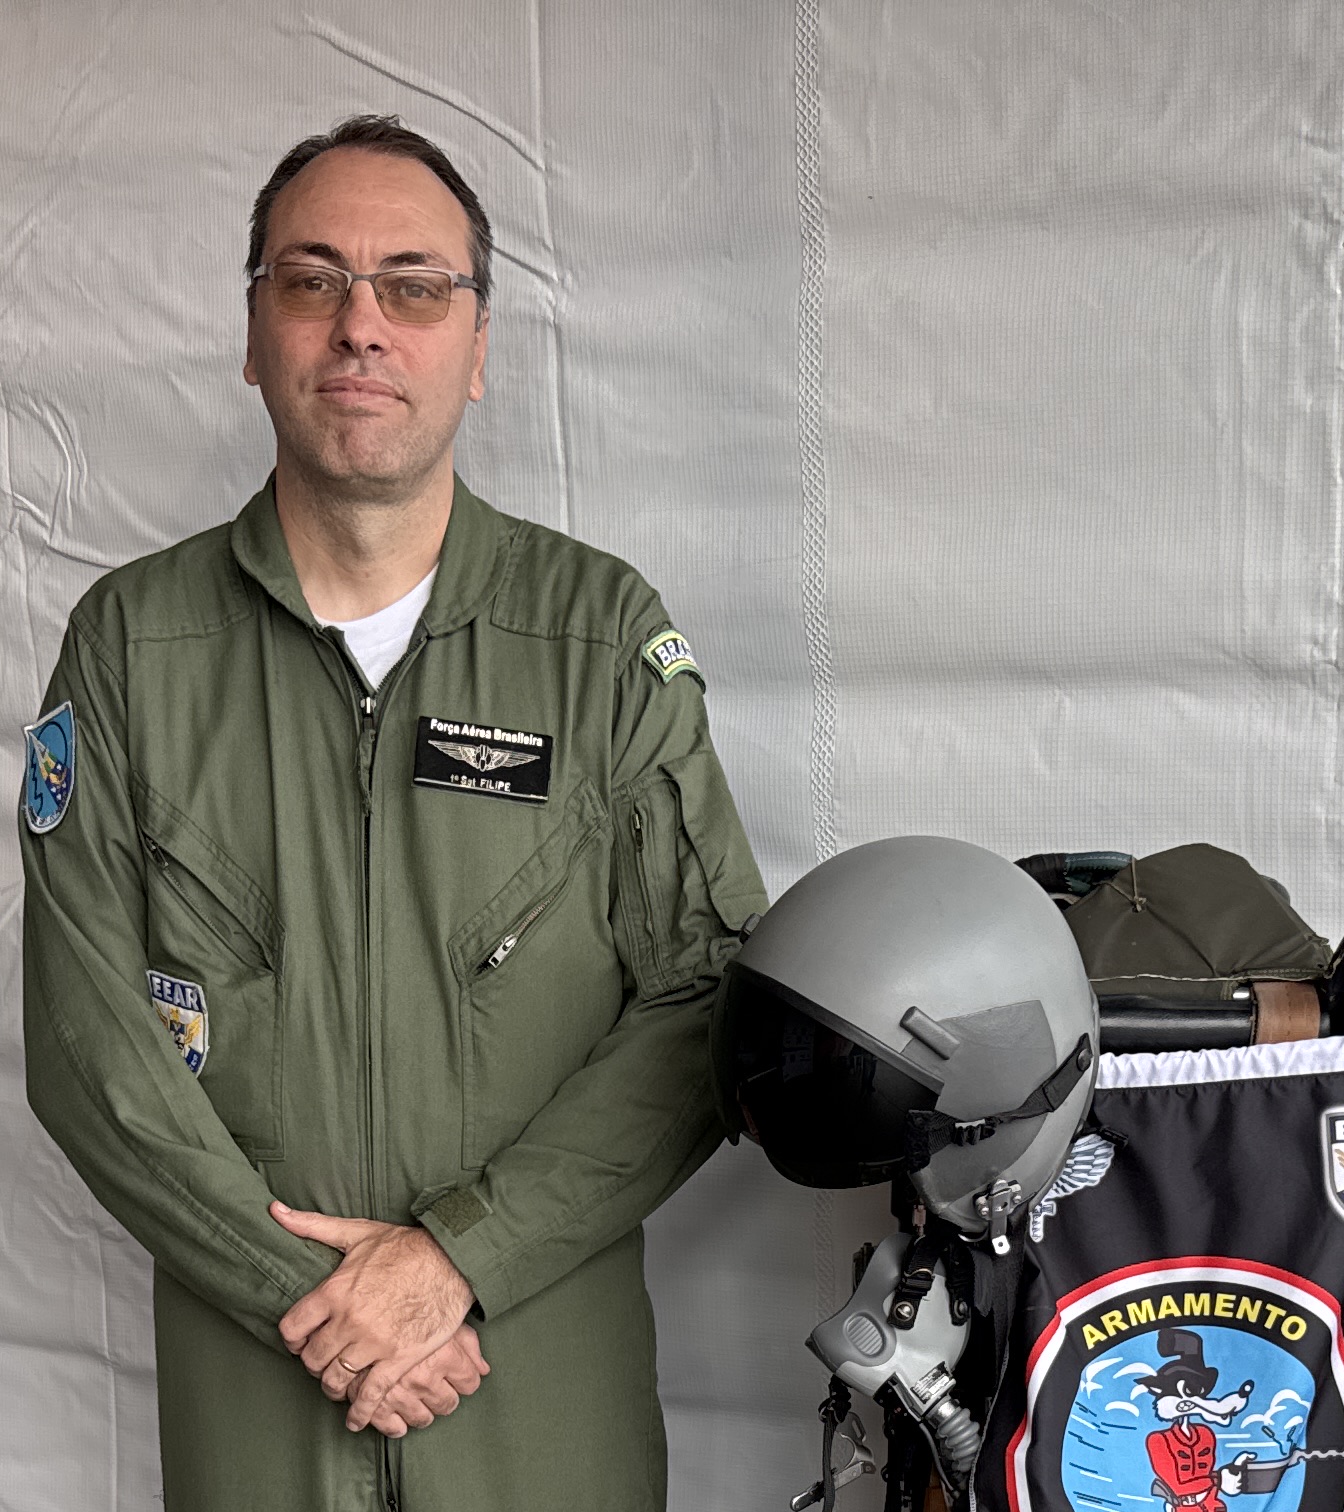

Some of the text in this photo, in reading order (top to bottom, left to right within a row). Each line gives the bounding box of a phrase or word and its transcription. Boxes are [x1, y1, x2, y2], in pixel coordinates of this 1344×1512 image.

[430, 718, 543, 747] Força Aérea Brasileira
[480, 778, 512, 793] FILIPE
[151, 976, 200, 1011] EEAR
[1081, 1292, 1308, 1351] ARMAMENTO
